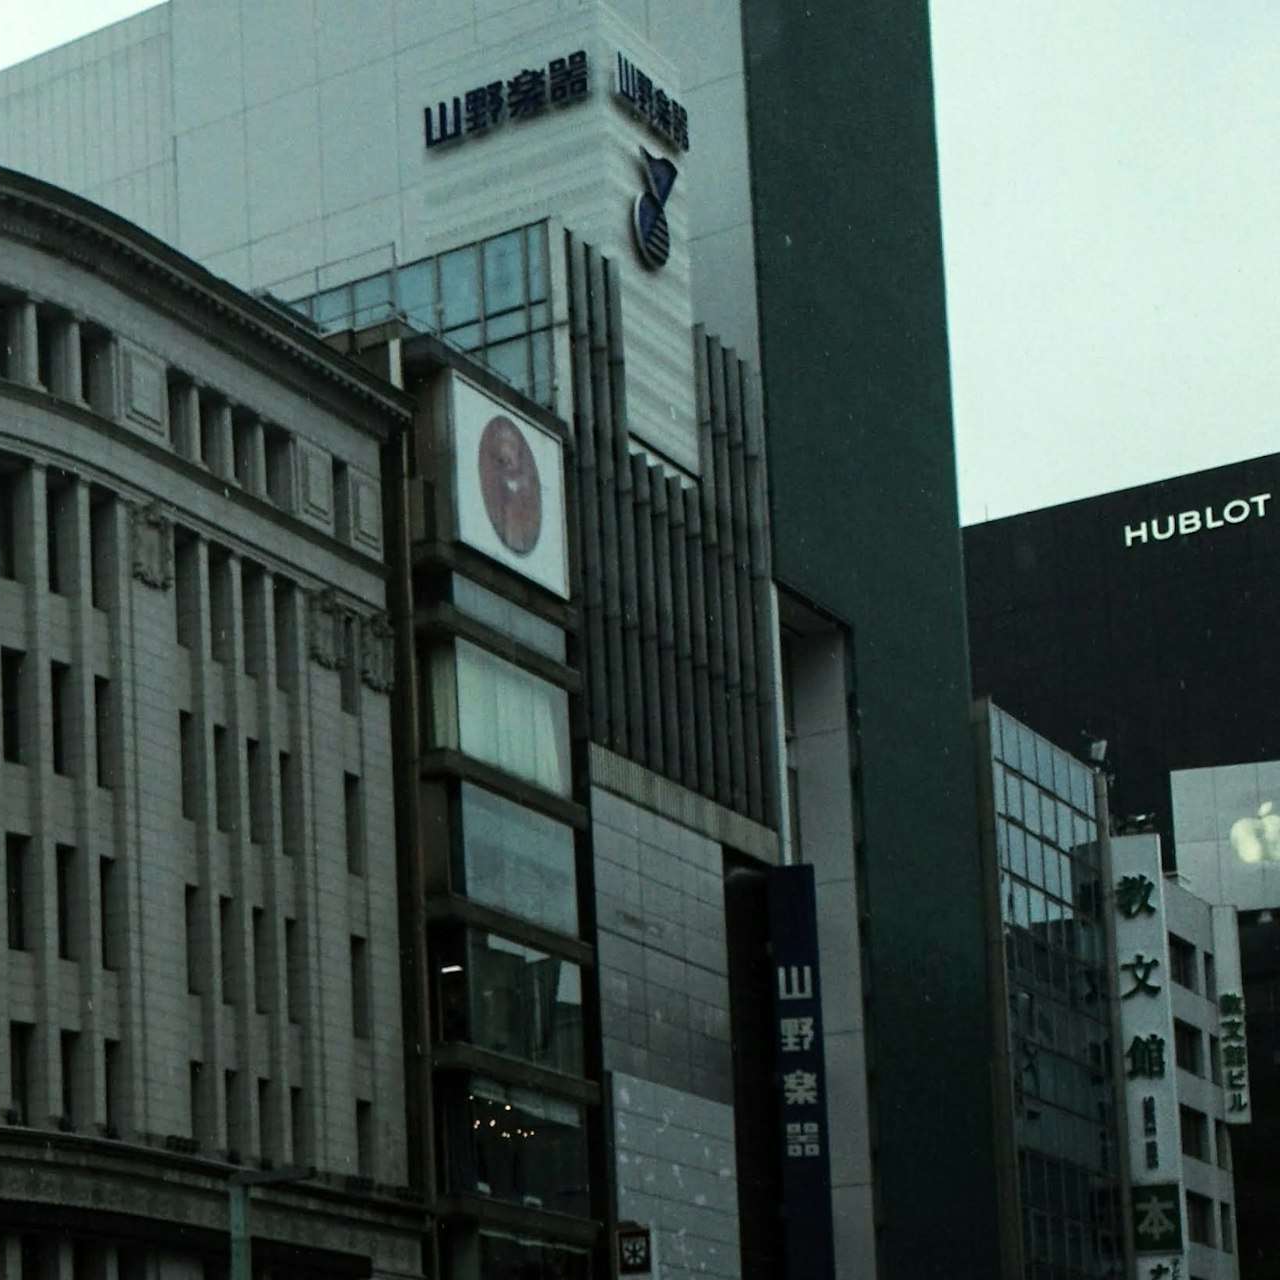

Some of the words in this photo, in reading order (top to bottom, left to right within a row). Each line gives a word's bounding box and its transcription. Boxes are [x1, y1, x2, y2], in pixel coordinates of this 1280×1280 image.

[424, 50, 588, 148] 山野楽器
[1124, 492, 1272, 548] HUBLOT
[1115, 874, 1166, 1079] 教文館
[777, 964, 821, 1158] 山野楽器
[1135, 1195, 1176, 1242] 本
